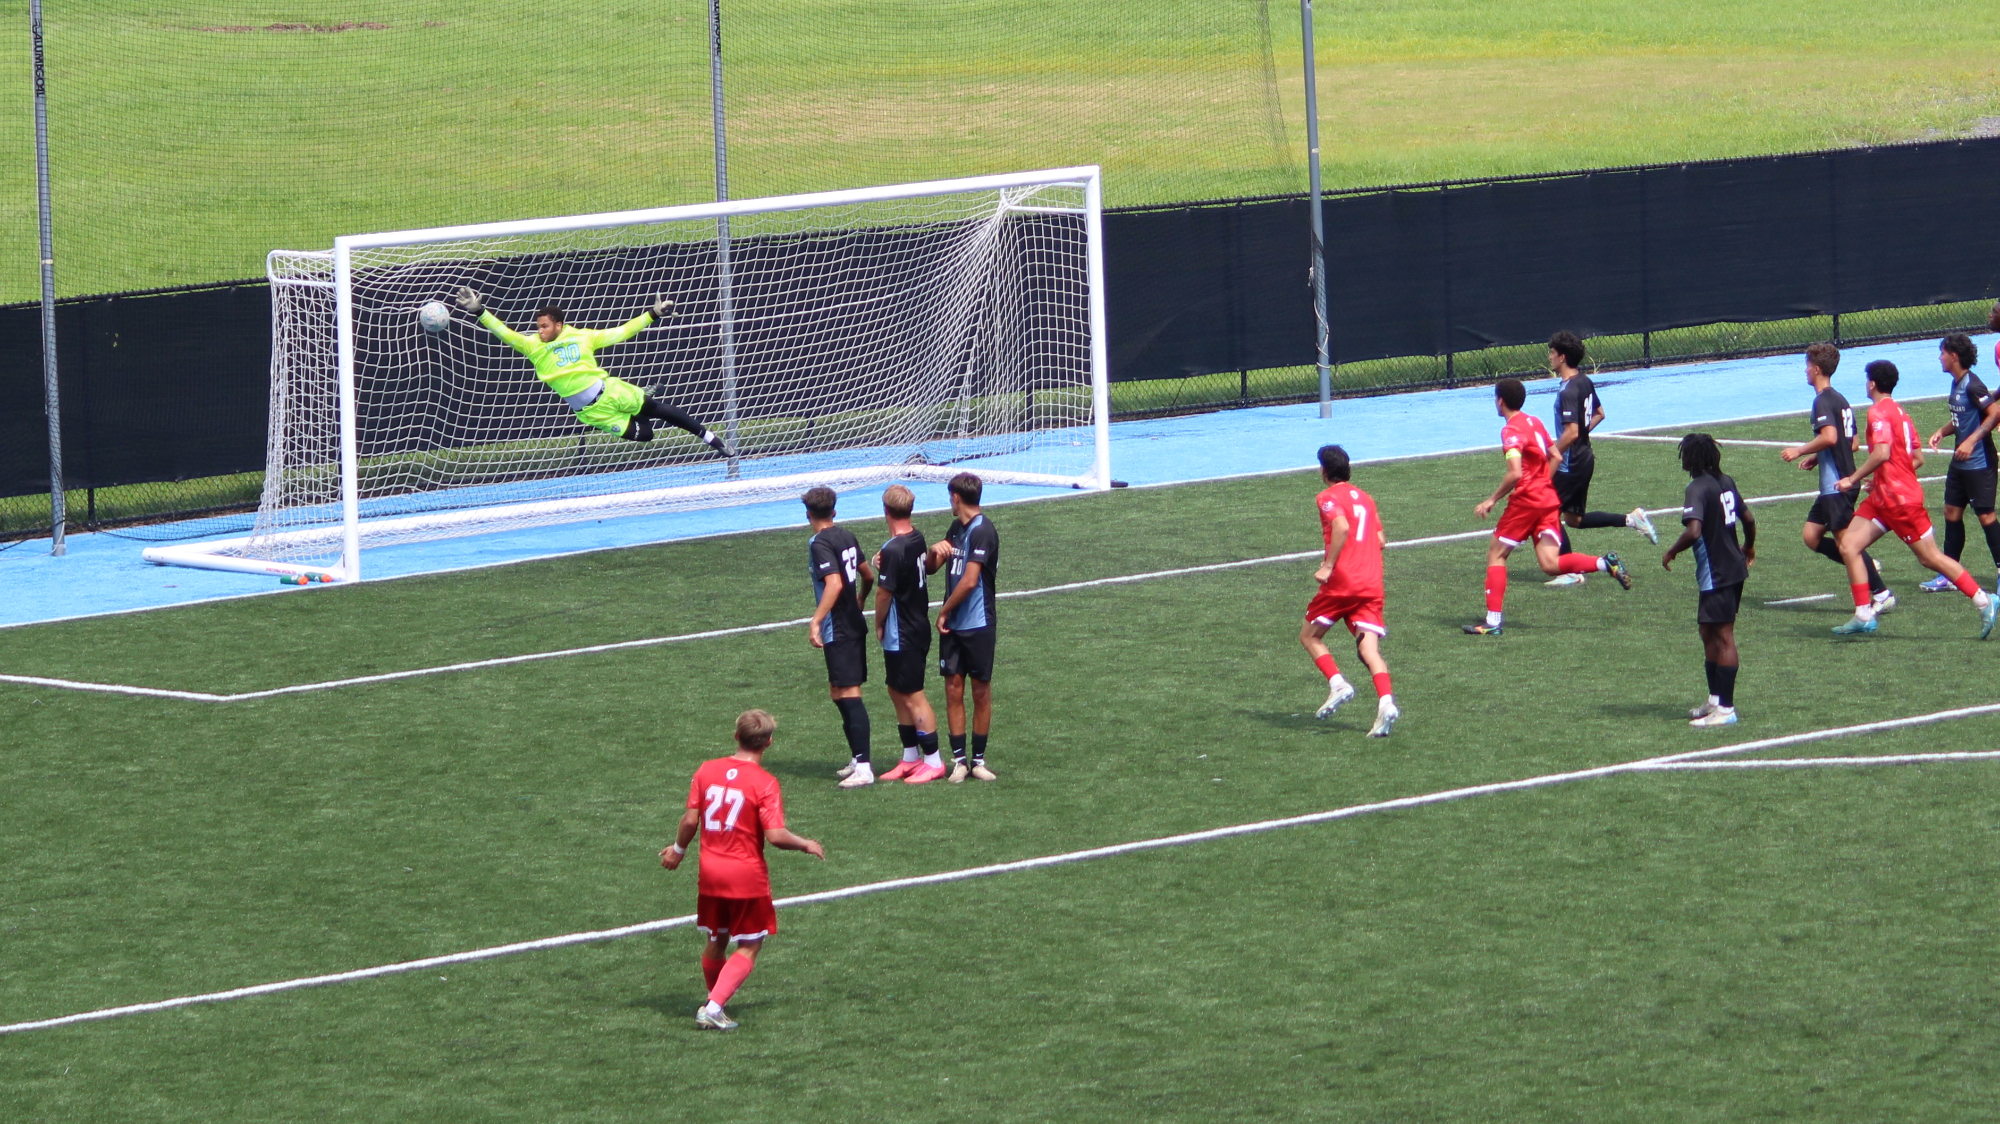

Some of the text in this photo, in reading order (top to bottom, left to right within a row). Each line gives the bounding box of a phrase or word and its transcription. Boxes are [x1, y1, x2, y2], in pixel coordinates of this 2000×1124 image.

[553, 343, 580, 367] 30
[1352, 503, 1367, 542] 7
[1720, 490, 1736, 525] 12
[950, 557, 964, 576] 10
[704, 783, 745, 832] 27
